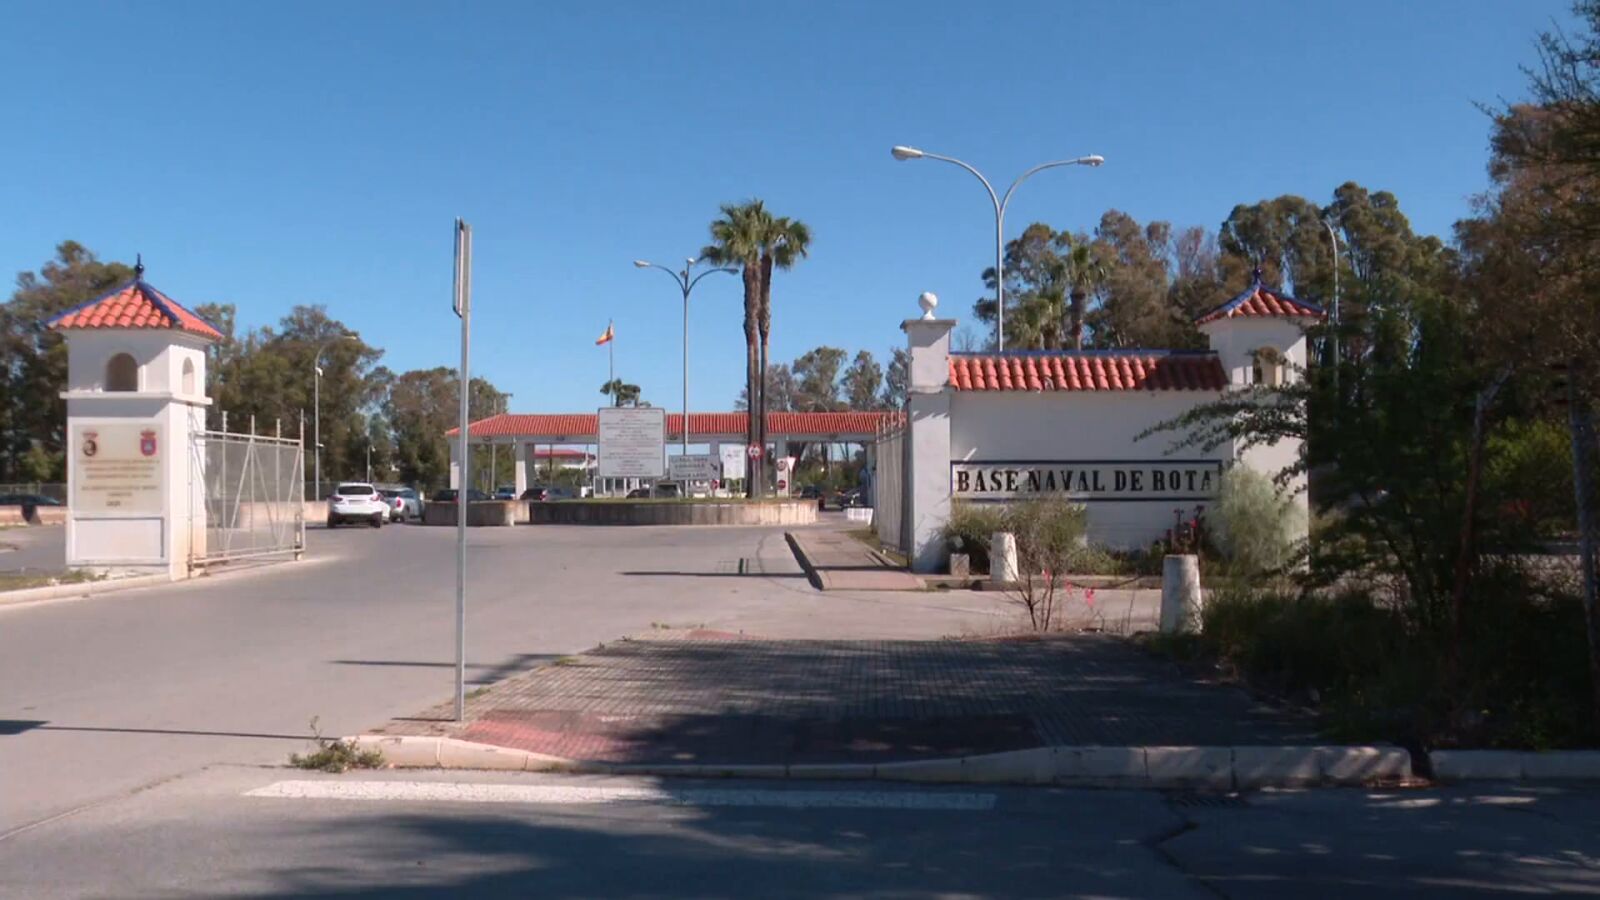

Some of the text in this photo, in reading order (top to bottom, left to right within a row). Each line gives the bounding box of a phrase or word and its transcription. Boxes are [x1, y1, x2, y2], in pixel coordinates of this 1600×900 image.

[957, 470, 1211, 492] BASE NAVAL DE ROTA
